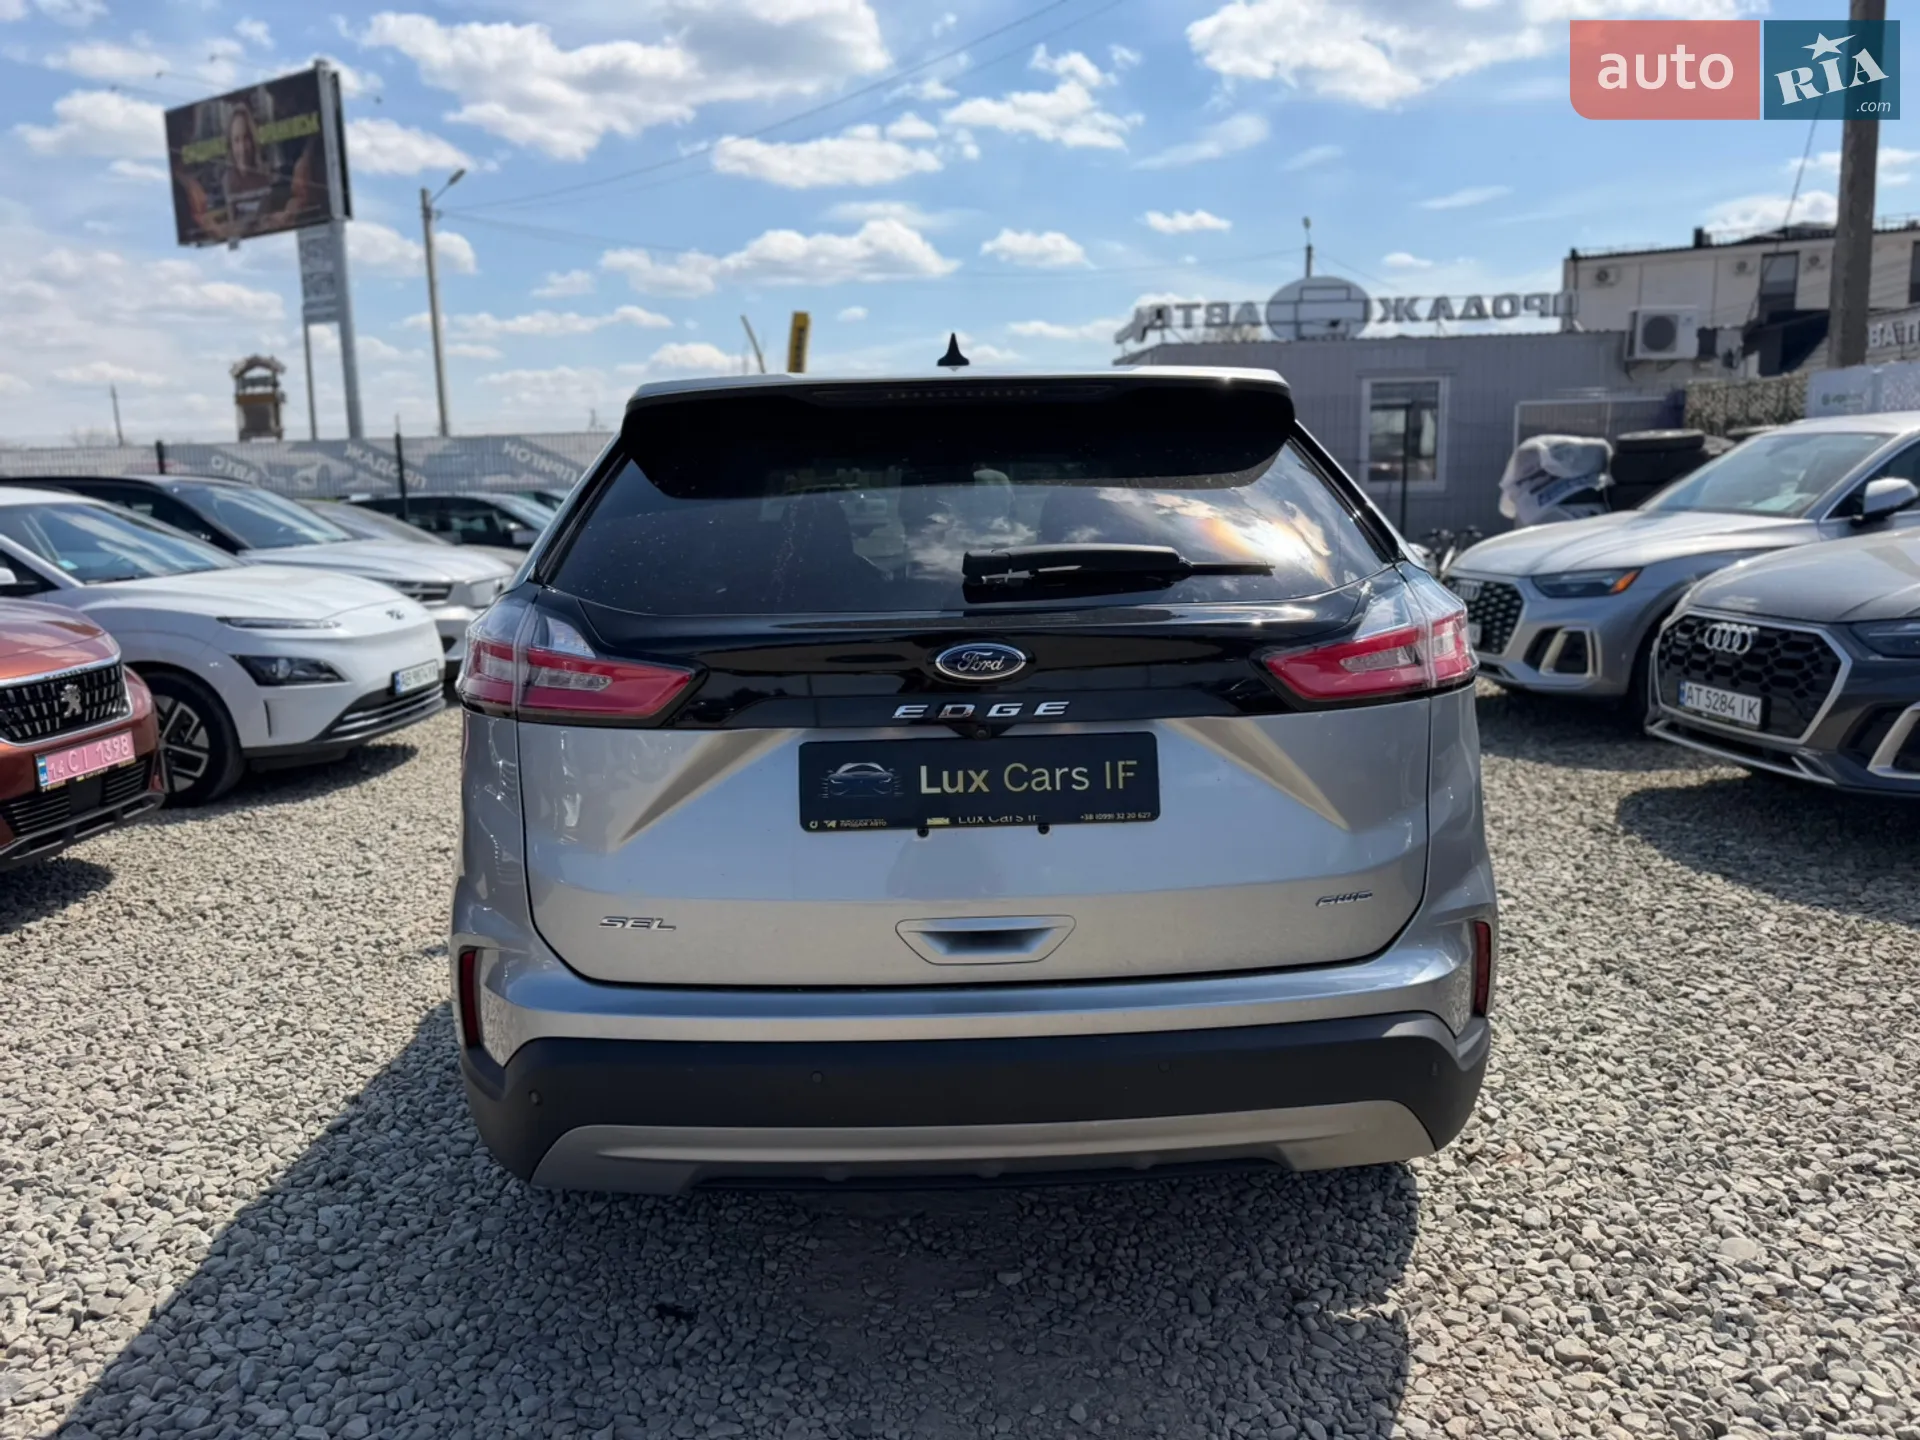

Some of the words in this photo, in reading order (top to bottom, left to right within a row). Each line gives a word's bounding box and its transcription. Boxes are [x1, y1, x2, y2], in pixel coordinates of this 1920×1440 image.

[957, 650, 1005, 671] Ford
[892, 701, 1070, 719] EDGE
[1686, 686, 1704, 707] AT
[1704, 690, 1737, 715] 5284
[1740, 699, 1759, 722] IK
[68, 746, 89, 773] CI
[95, 735, 131, 764] 1398
[920, 765, 990, 794] Lux
[1003, 762, 1090, 792] Cars
[1105, 760, 1138, 790] IF
[598, 915, 677, 932] SEL
